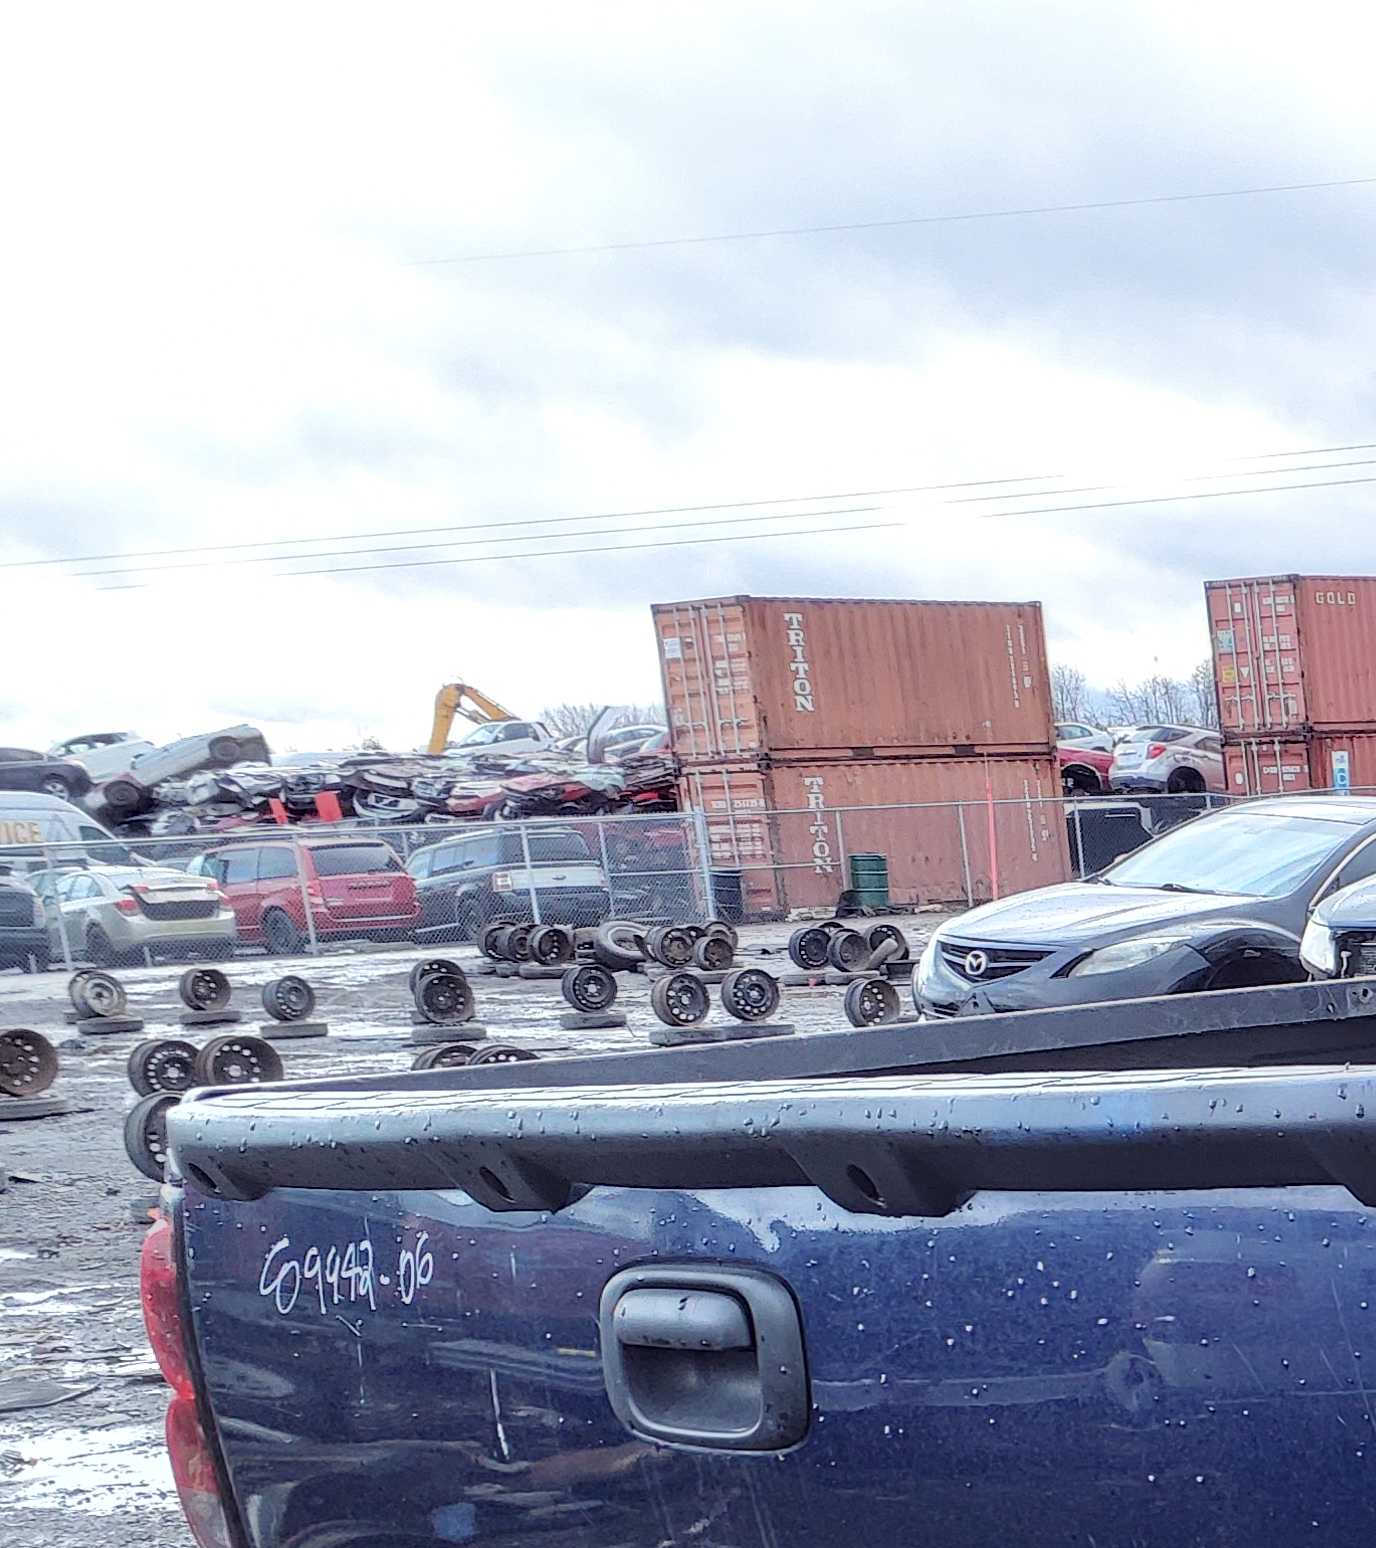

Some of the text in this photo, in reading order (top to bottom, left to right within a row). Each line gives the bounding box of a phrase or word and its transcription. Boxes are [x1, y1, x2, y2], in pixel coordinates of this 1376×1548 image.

[1314, 590, 1357, 606] GOLD
[783, 611, 815, 713] TRITON
[803, 776, 834, 874] TRITON
